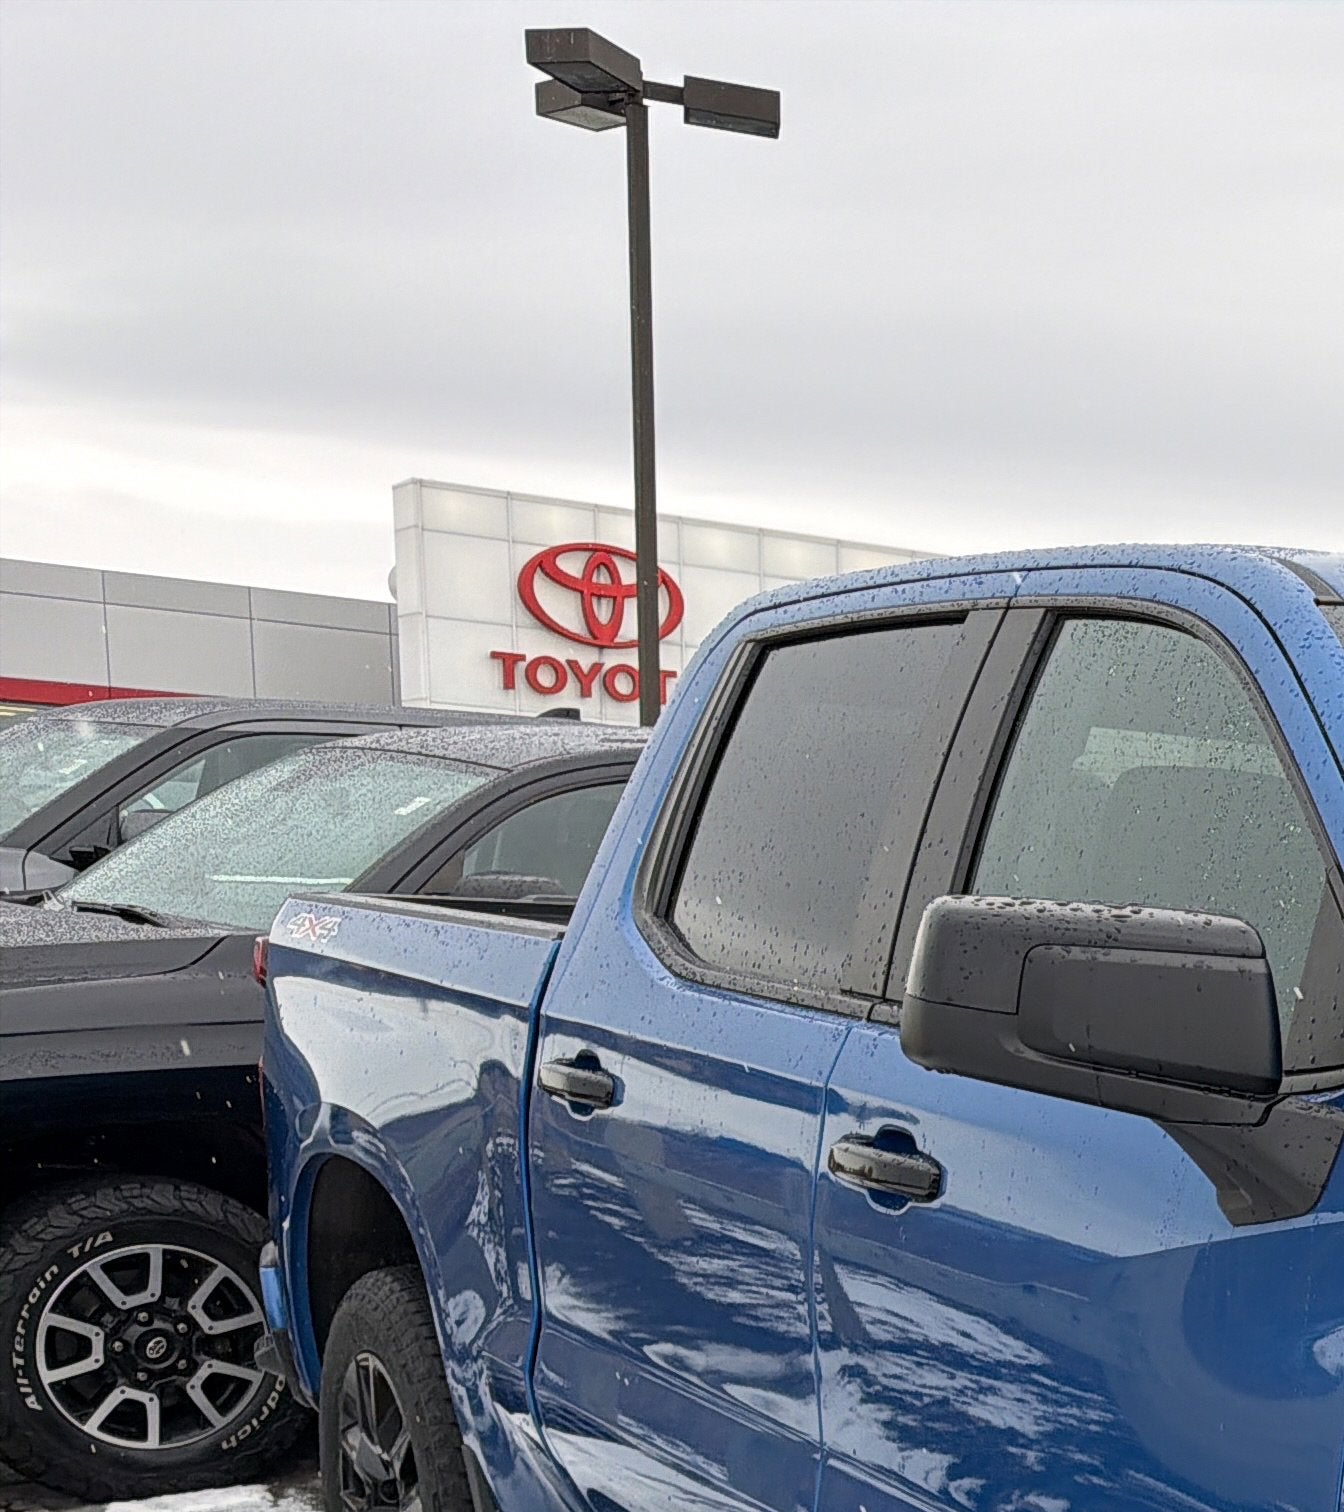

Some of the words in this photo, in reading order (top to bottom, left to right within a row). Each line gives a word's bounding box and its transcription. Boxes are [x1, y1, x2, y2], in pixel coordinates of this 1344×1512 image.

[490, 651, 677, 705] TOYOT
[12, 1264, 60, 1412] All-Terrain
[66, 1231, 114, 1259] T/A
[221, 1374, 286, 1451] odrich
